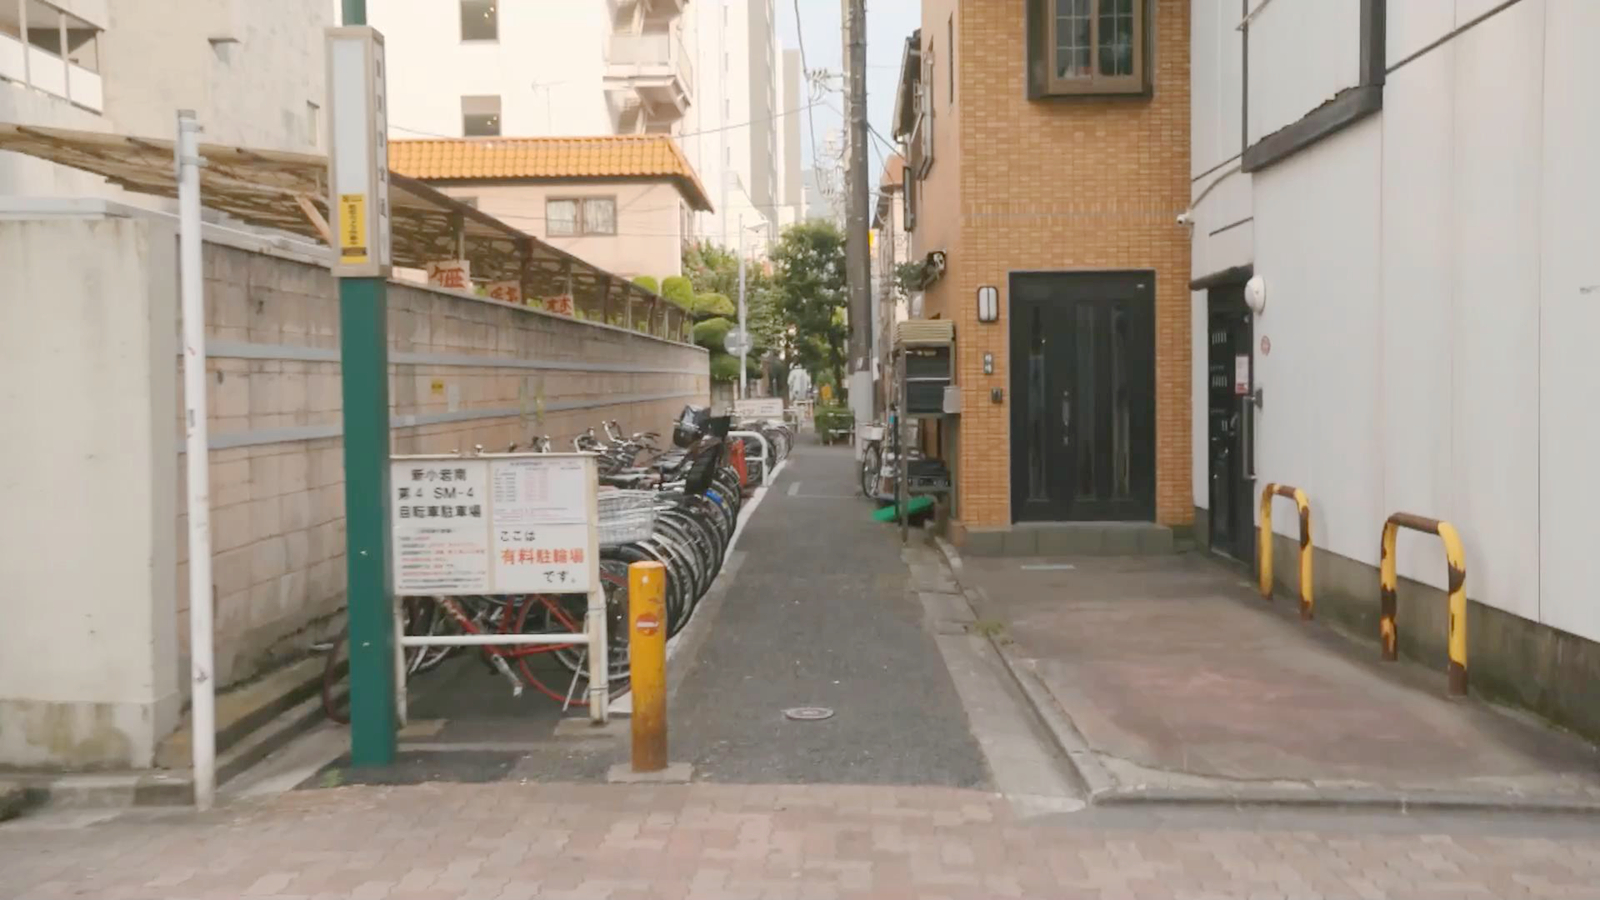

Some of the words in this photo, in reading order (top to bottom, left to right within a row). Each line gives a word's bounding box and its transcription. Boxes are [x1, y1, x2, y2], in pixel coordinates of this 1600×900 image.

[433, 487, 475, 500] SM-4
[398, 504, 482, 519] 自転車駐車場
[500, 530, 537, 542] ここは
[500, 548, 585, 566] 有料駐輪場
